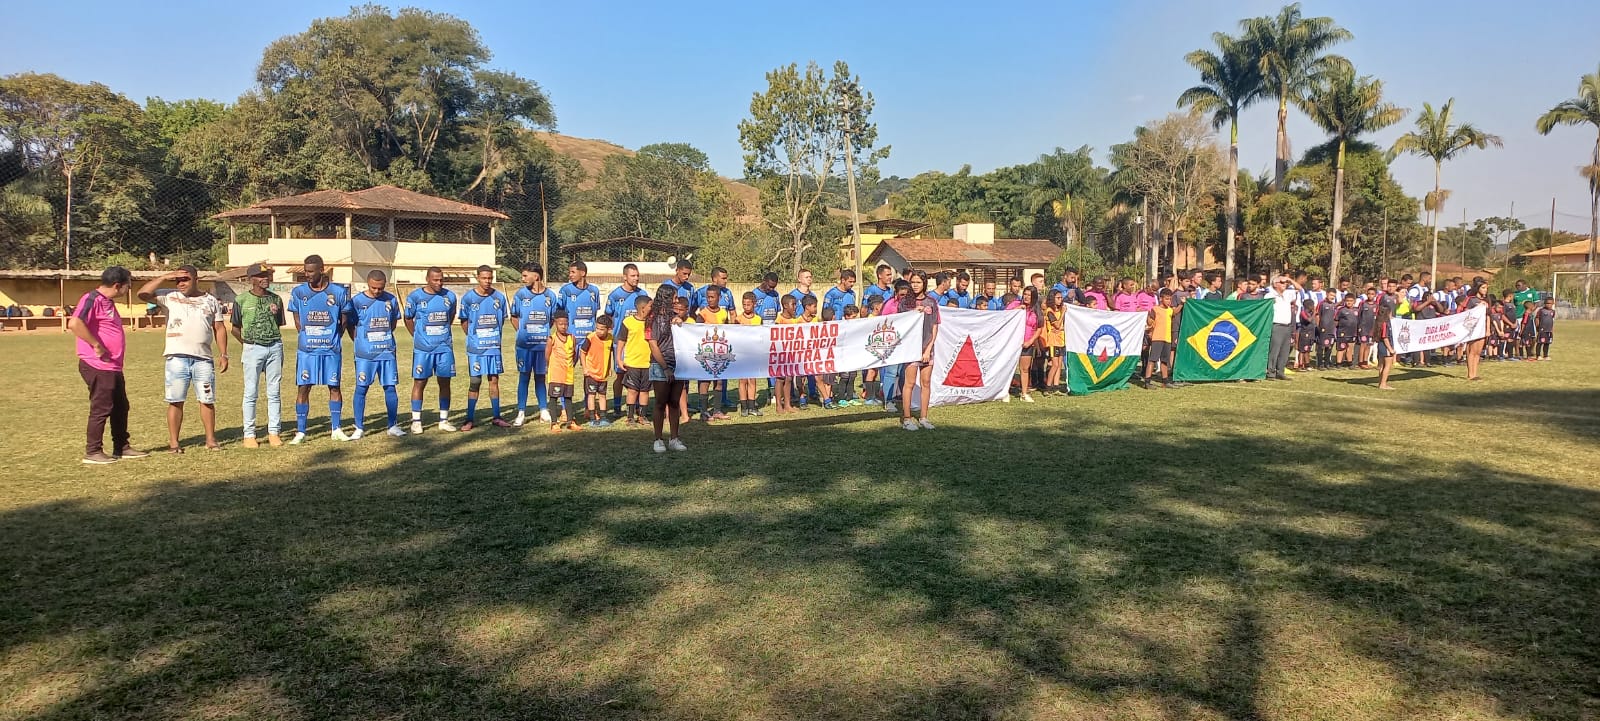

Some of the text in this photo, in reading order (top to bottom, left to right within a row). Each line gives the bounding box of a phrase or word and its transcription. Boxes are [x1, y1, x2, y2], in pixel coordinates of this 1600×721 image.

[770, 322, 838, 341] DIGA NÃO
[769, 337, 836, 352] A VIOLENCIA
[768, 347, 835, 364] CONTRA A
